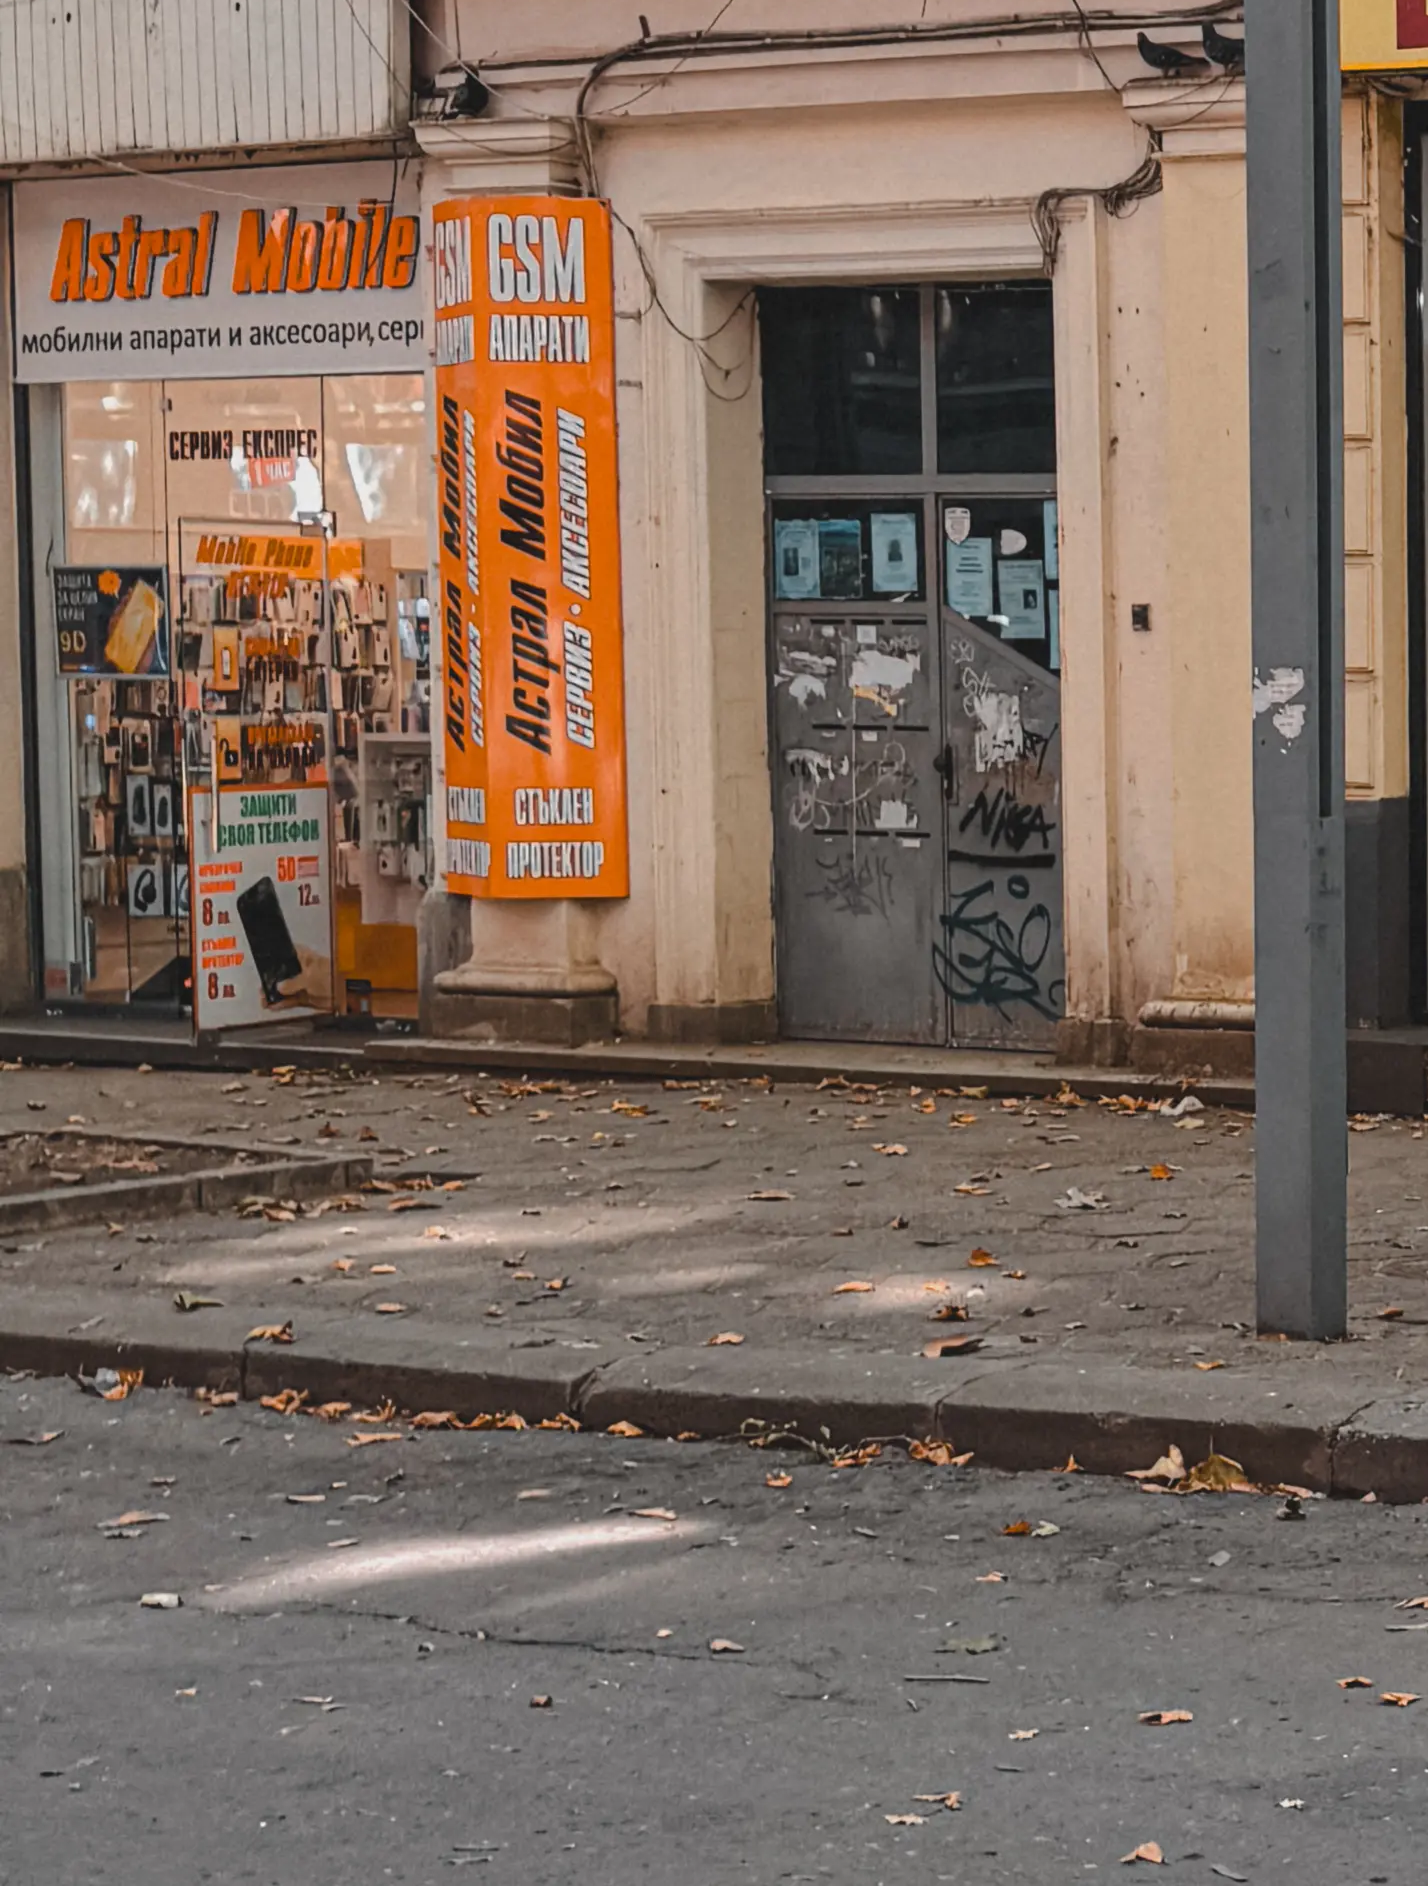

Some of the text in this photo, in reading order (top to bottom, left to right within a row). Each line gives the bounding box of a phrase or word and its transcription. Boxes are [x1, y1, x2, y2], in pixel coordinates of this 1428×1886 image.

[50, 200, 421, 302] Astral Mobile
[488, 213, 586, 304] GSM
[22, 325, 123, 355] мобилни
[129, 325, 221, 355] апарати
[229, 327, 242, 347] и
[378, 317, 424, 349] сер
[489, 314, 590, 363] АПАРАТИ
[170, 429, 317, 460] СЕРВИЗ ЕКСПРЕС
[496, 389, 561, 755] Астрал Мобил
[556, 406, 596, 749] СЕРВИЗ АКСЕСОАРИ
[60, 630, 86, 653] 9D
[240, 794, 297, 819] ЗАЩИТИ
[514, 788, 594, 825] СТЪКЛЕН
[257, 819, 319, 844] ТЕЛЕФОН
[507, 842, 604, 878] ПРОТЕКТОР
